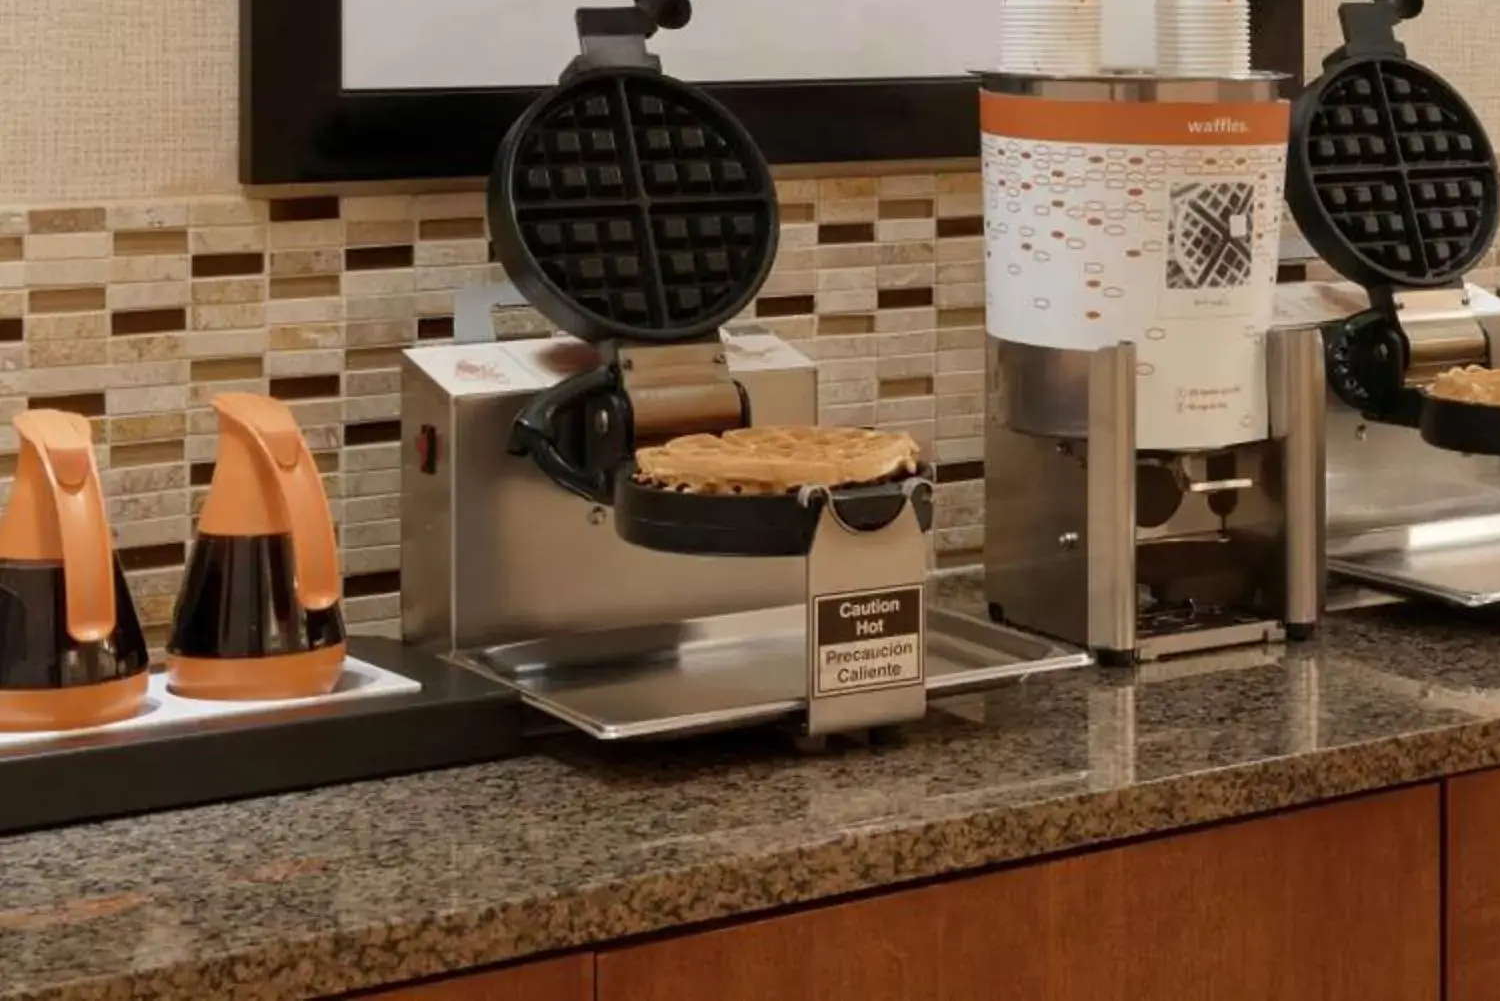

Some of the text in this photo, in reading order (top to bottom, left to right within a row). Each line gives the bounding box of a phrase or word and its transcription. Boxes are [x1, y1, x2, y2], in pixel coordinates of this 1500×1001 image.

[840, 599, 900, 618] Caution
[856, 618, 884, 636] Hot
[838, 663, 902, 683] Caliente
